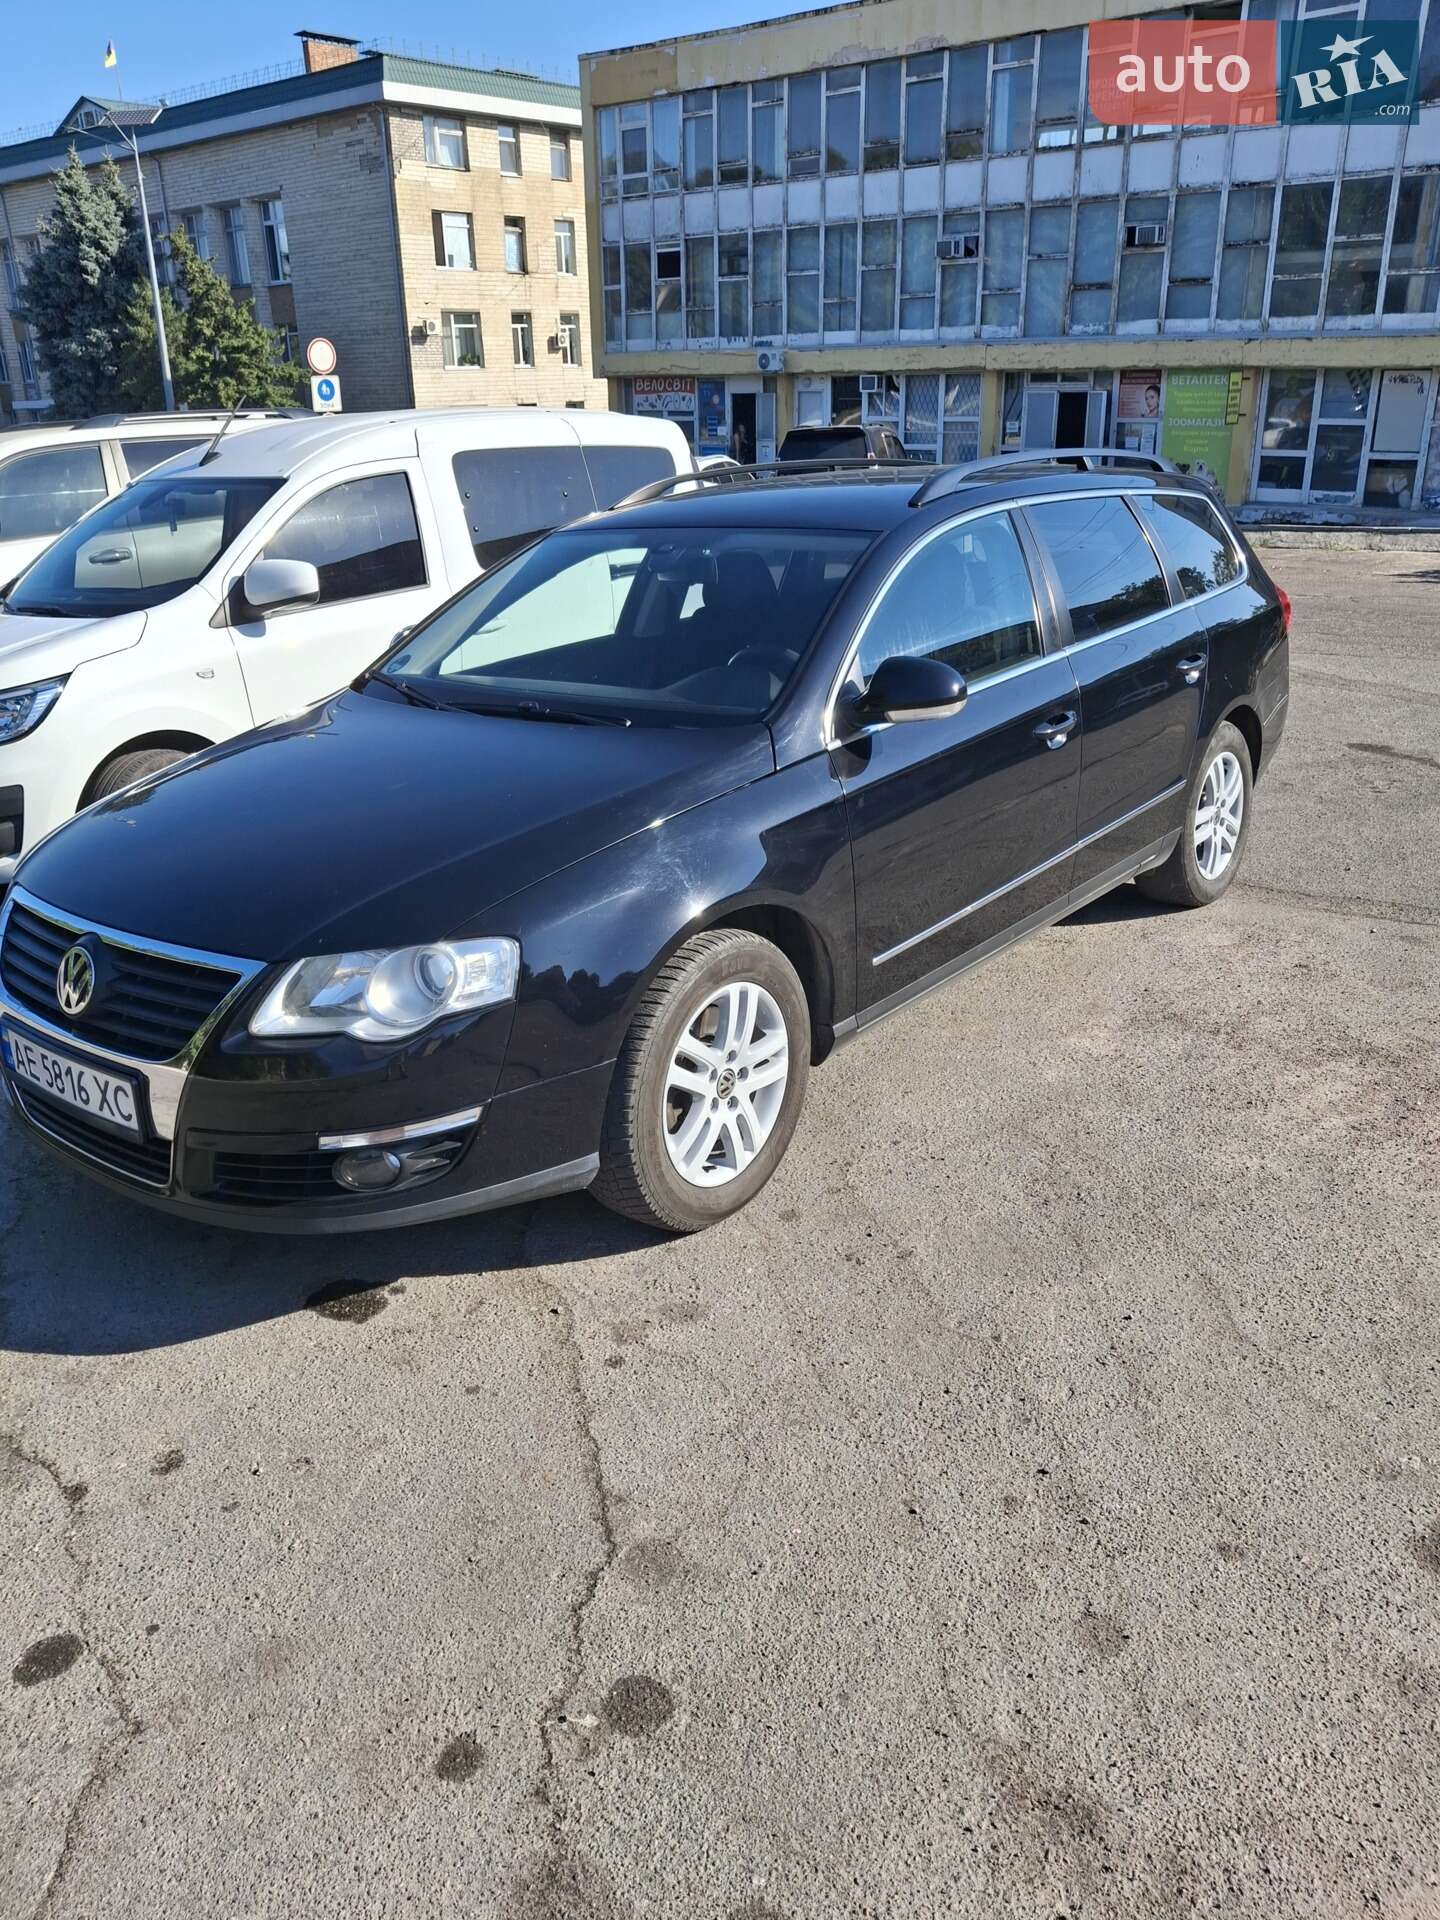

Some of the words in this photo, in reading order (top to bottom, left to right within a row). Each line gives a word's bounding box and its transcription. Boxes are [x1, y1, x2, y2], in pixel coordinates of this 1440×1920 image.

[635, 378, 692, 393] ВЕЛОСВІТ
[1171, 375, 1228, 385] ВЕТАПТЕК
[14, 1039, 41, 1082] AE
[40, 1053, 91, 1106] 5816
[92, 1075, 133, 1122] XC
